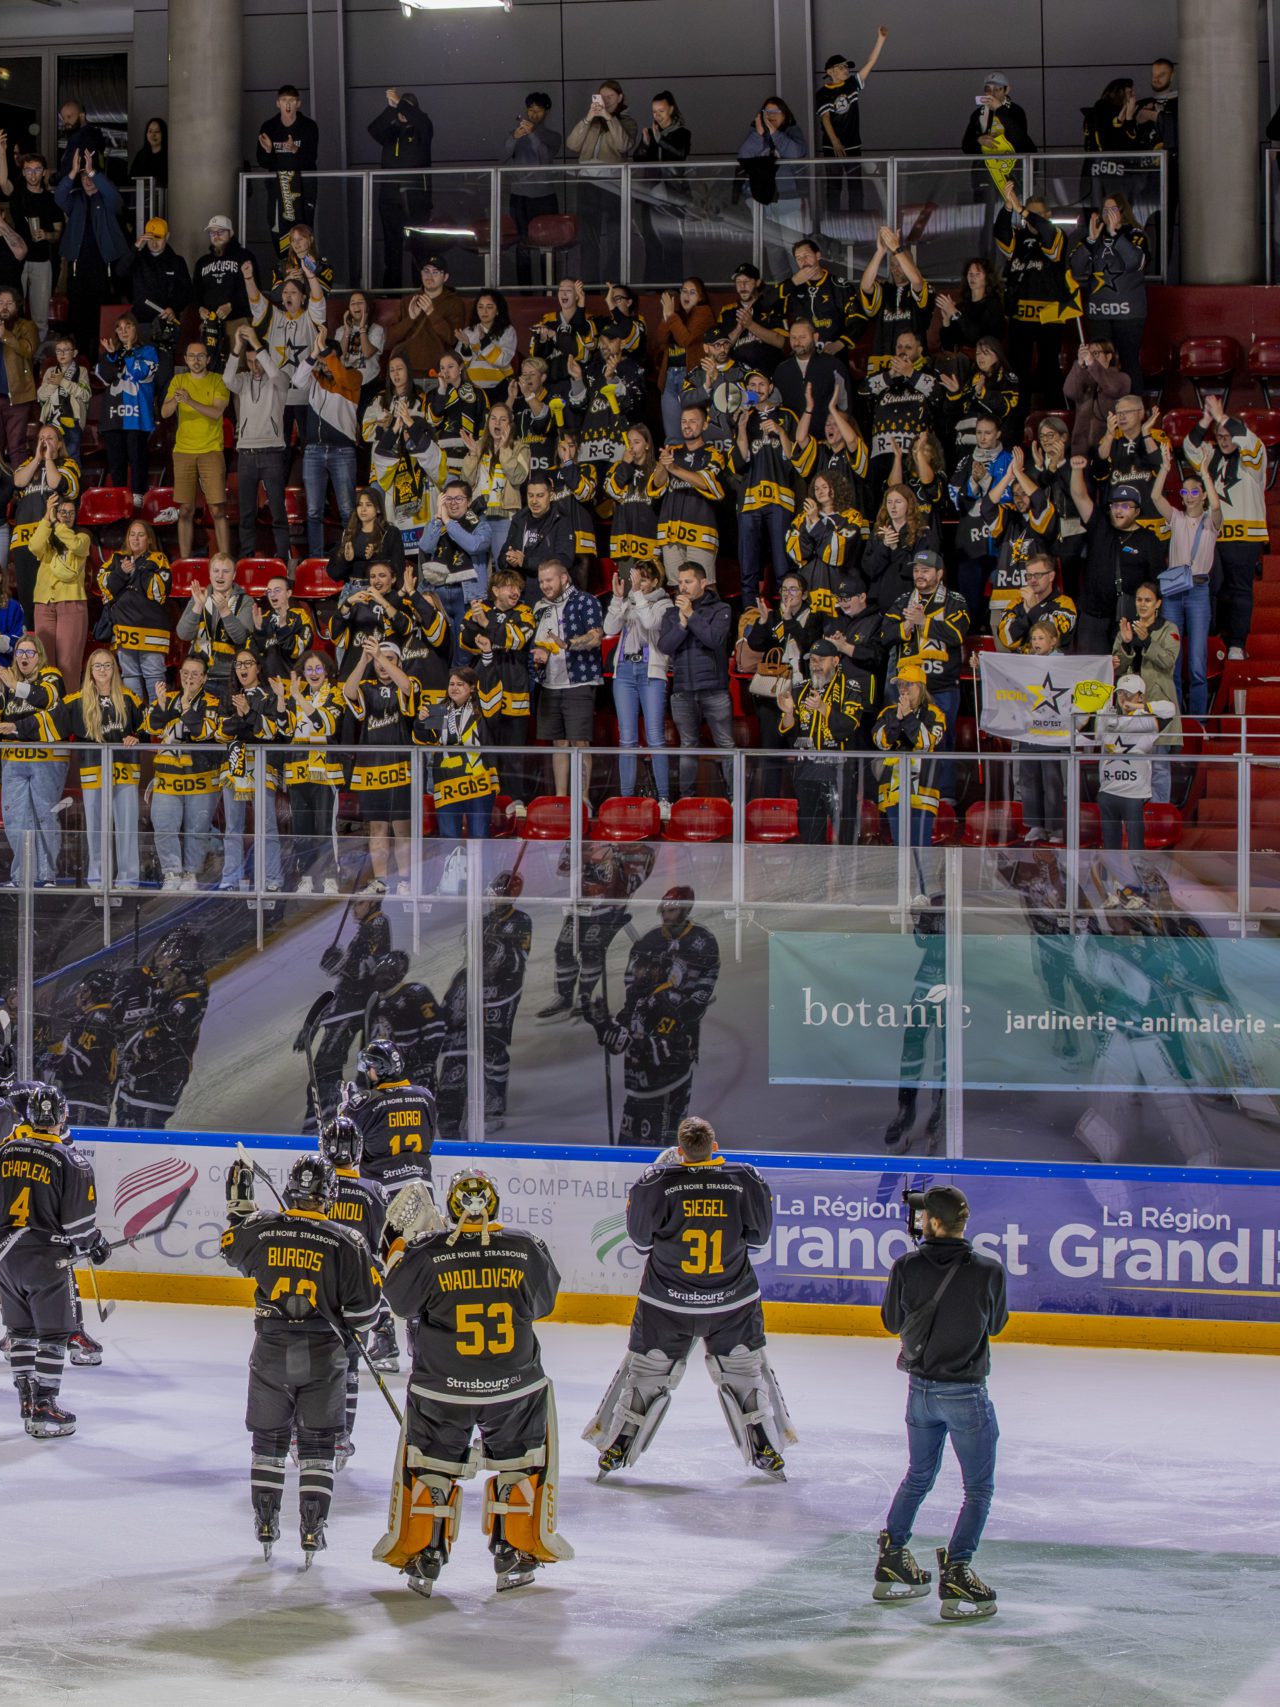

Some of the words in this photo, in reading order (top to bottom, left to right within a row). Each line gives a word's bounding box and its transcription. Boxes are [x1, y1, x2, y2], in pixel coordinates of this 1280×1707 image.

[1089, 302, 1130, 315] R-GDS
[157, 776, 206, 792] R-GDS
[366, 766, 407, 787] R-GDS
[1104, 770, 1138, 781] R-GDS
[443, 777, 489, 800] R-GDS
[1005, 1010, 1115, 1034] jardinerie
[1142, 1012, 1266, 1034] animalerie
[388, 1110, 421, 1127] GIORGI
[74, 1148, 95, 1158] ockey
[508, 1177, 636, 1199] COMPTABLE
[684, 1183, 704, 1193] NOIRE
[9, 1186, 31, 1227] 4
[684, 1200, 728, 1218] SIEGEL
[776, 1195, 804, 1215] La
[813, 1195, 901, 1223] Région
[1103, 1205, 1132, 1227] La
[1142, 1205, 1231, 1233] Région
[275, 1230, 297, 1238] NOIRE
[268, 1248, 322, 1271] BURGOS
[432, 1252, 457, 1263] ETOILE
[458, 1250, 481, 1260] NOIRE
[484, 1250, 529, 1261] STRASBOURG
[681, 1229, 725, 1275] 31
[1049, 1223, 1249, 1285] Grand
[456, 1302, 515, 1356] 53
